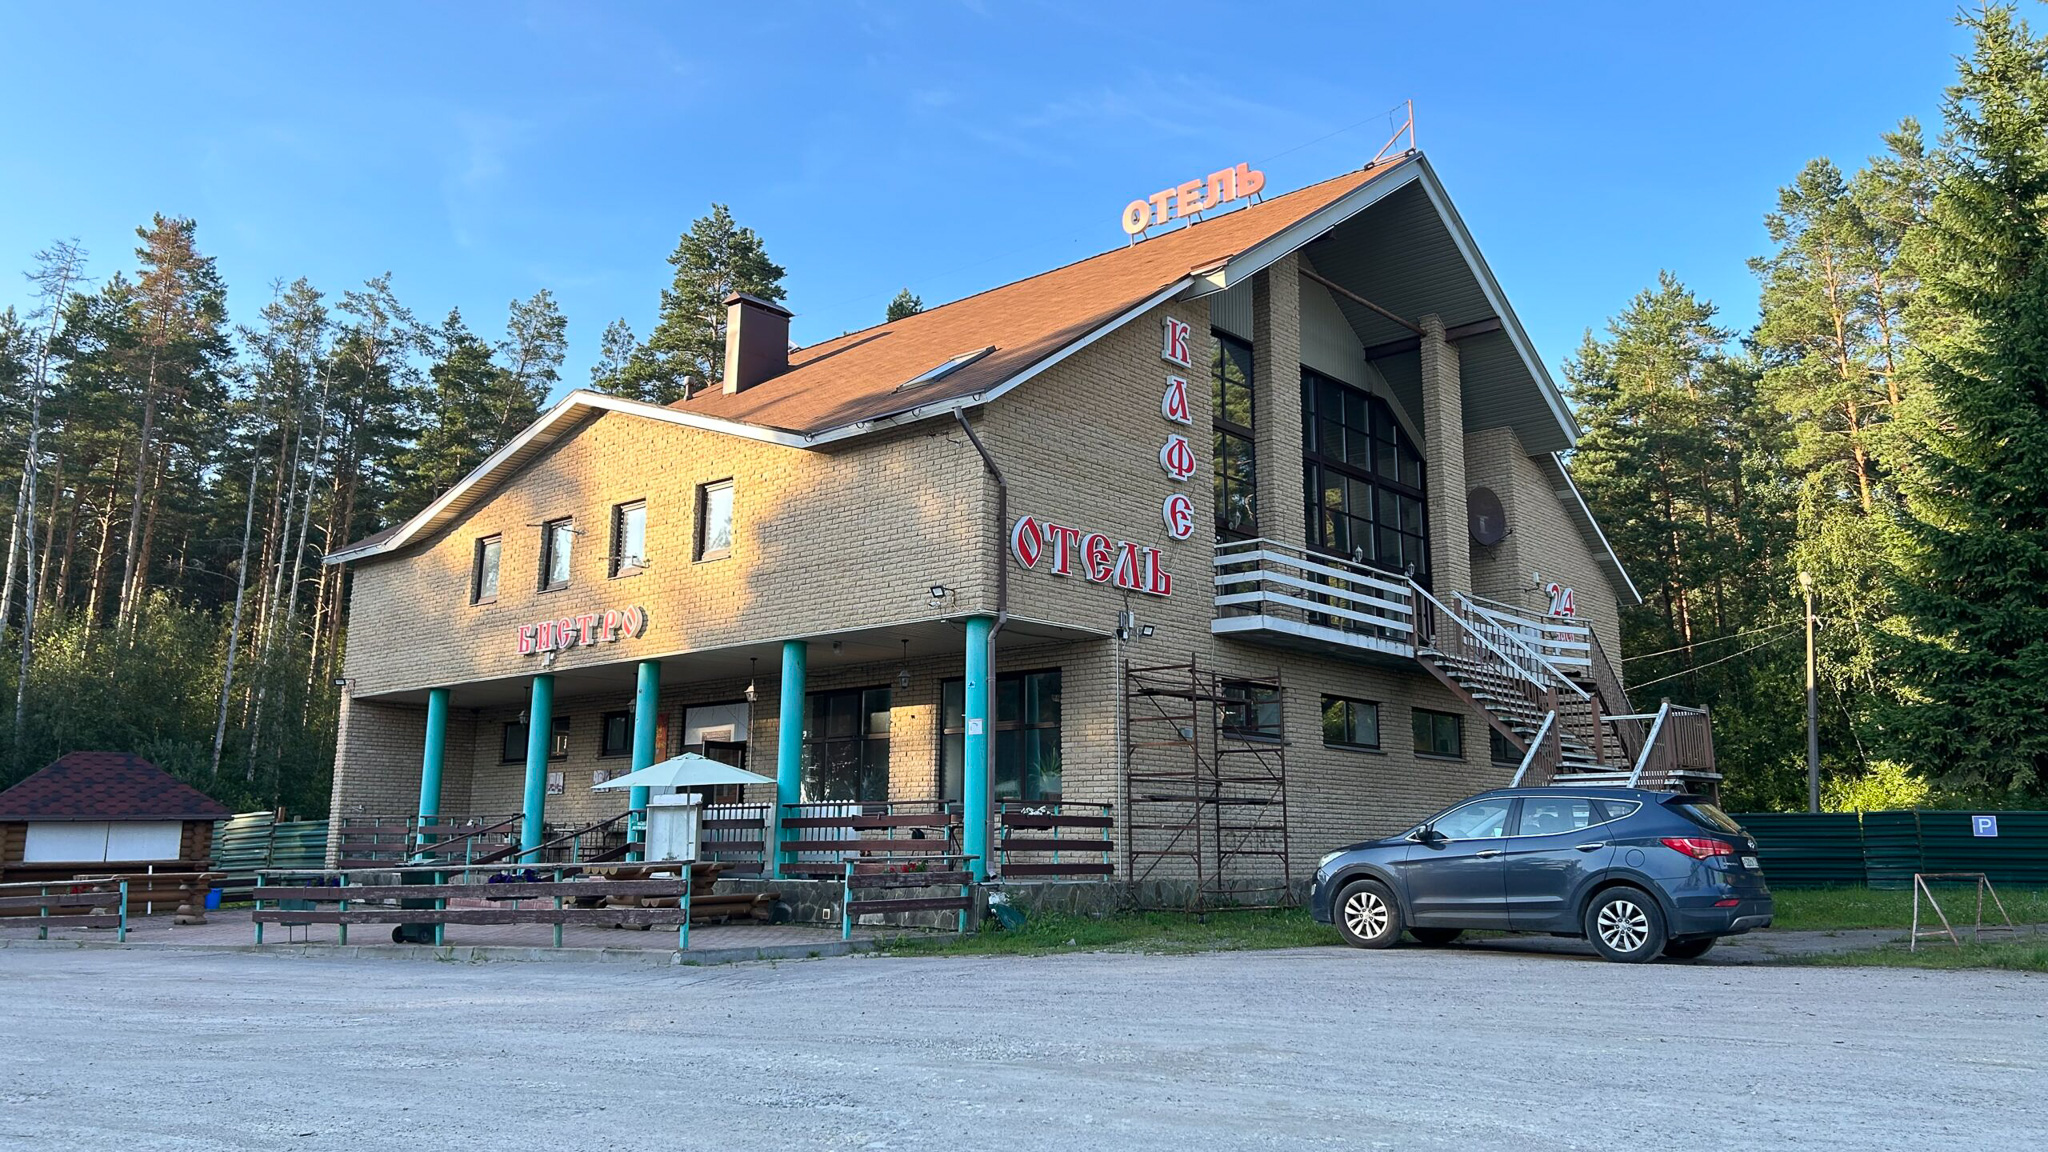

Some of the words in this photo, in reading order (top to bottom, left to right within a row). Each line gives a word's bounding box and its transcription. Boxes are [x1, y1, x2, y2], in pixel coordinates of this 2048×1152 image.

[1122, 162, 1265, 234] ОТЕЛЬ
[1161, 315, 1196, 540] КАФЕ
[1011, 515, 1172, 597] ОТЕЛЬ
[517, 604, 643, 655] БИСТРО
[1546, 583, 1575, 620] 24
[1978, 818, 1992, 834] P
